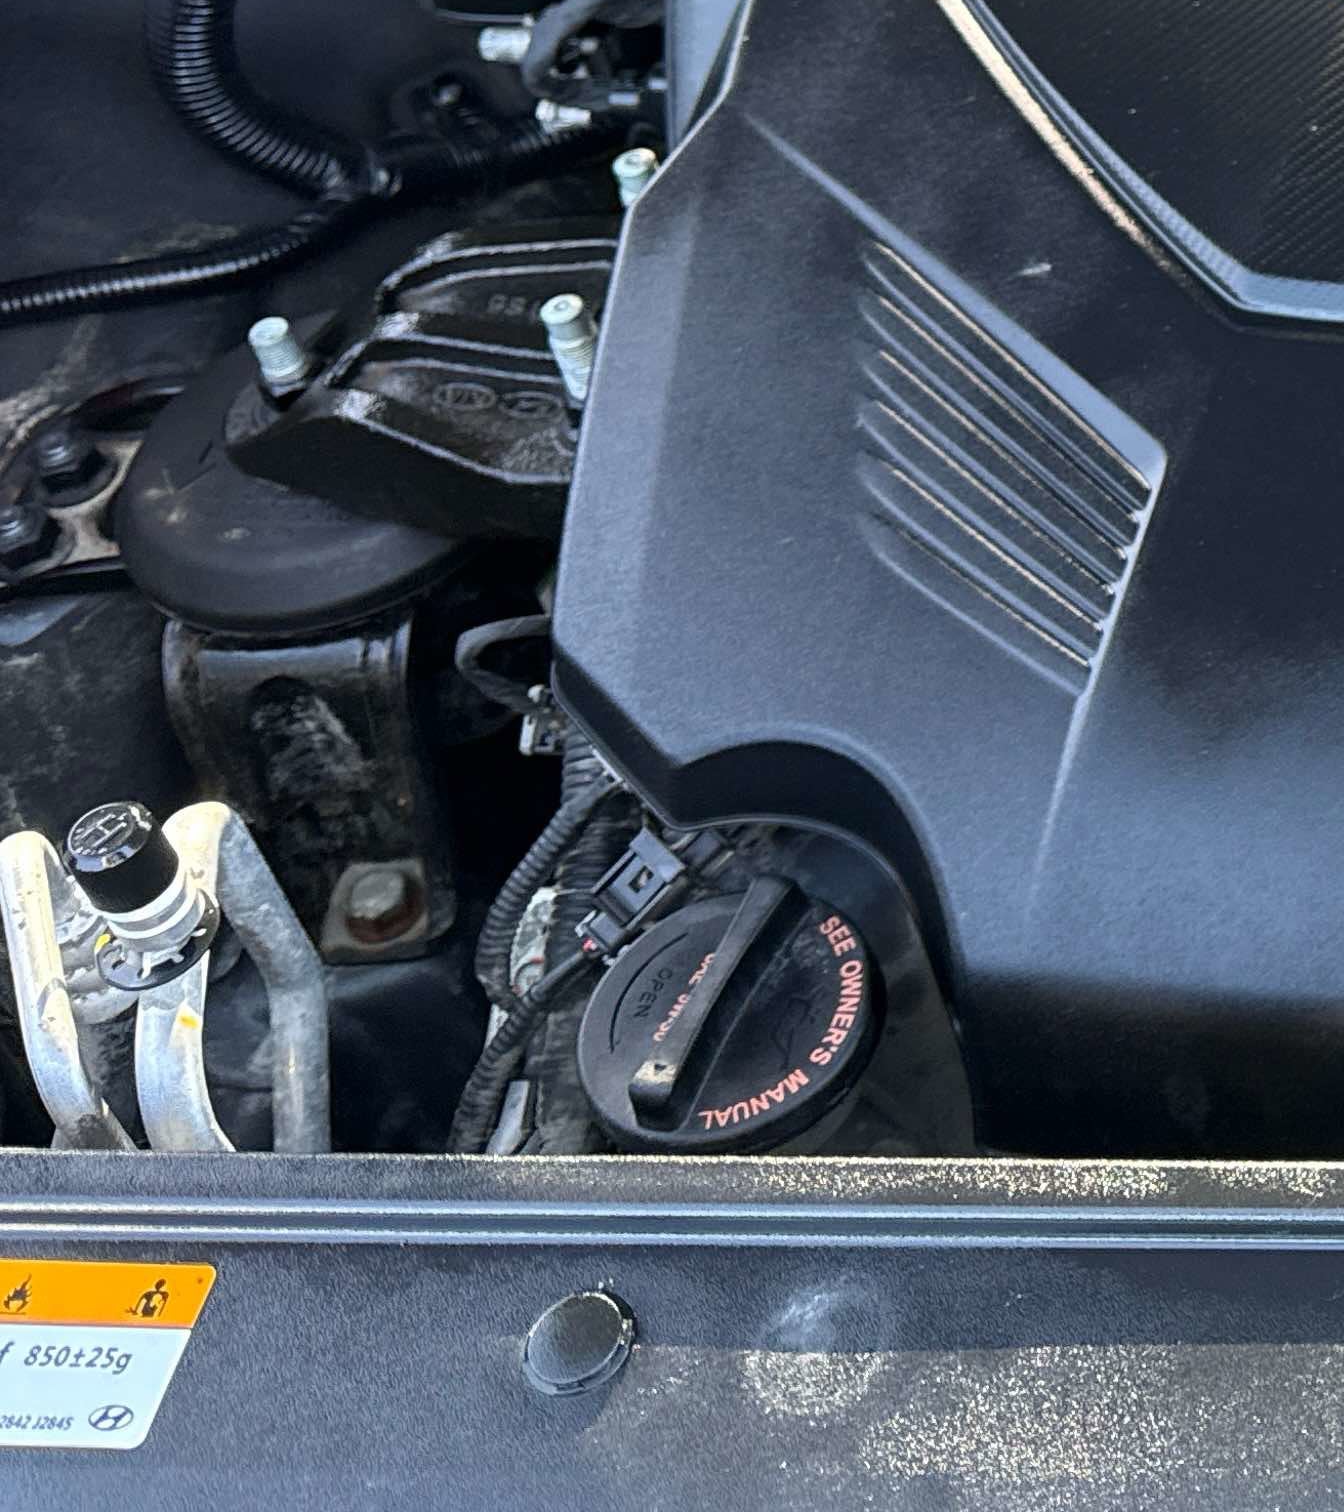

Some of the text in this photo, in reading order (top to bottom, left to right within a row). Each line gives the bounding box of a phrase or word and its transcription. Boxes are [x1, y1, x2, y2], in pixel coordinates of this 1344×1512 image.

[633, 968, 673, 1018] OPEN
[699, 915, 864, 1129] SEE OWNER'S MANUAL
[23, 1344, 133, 1376] 850±25g
